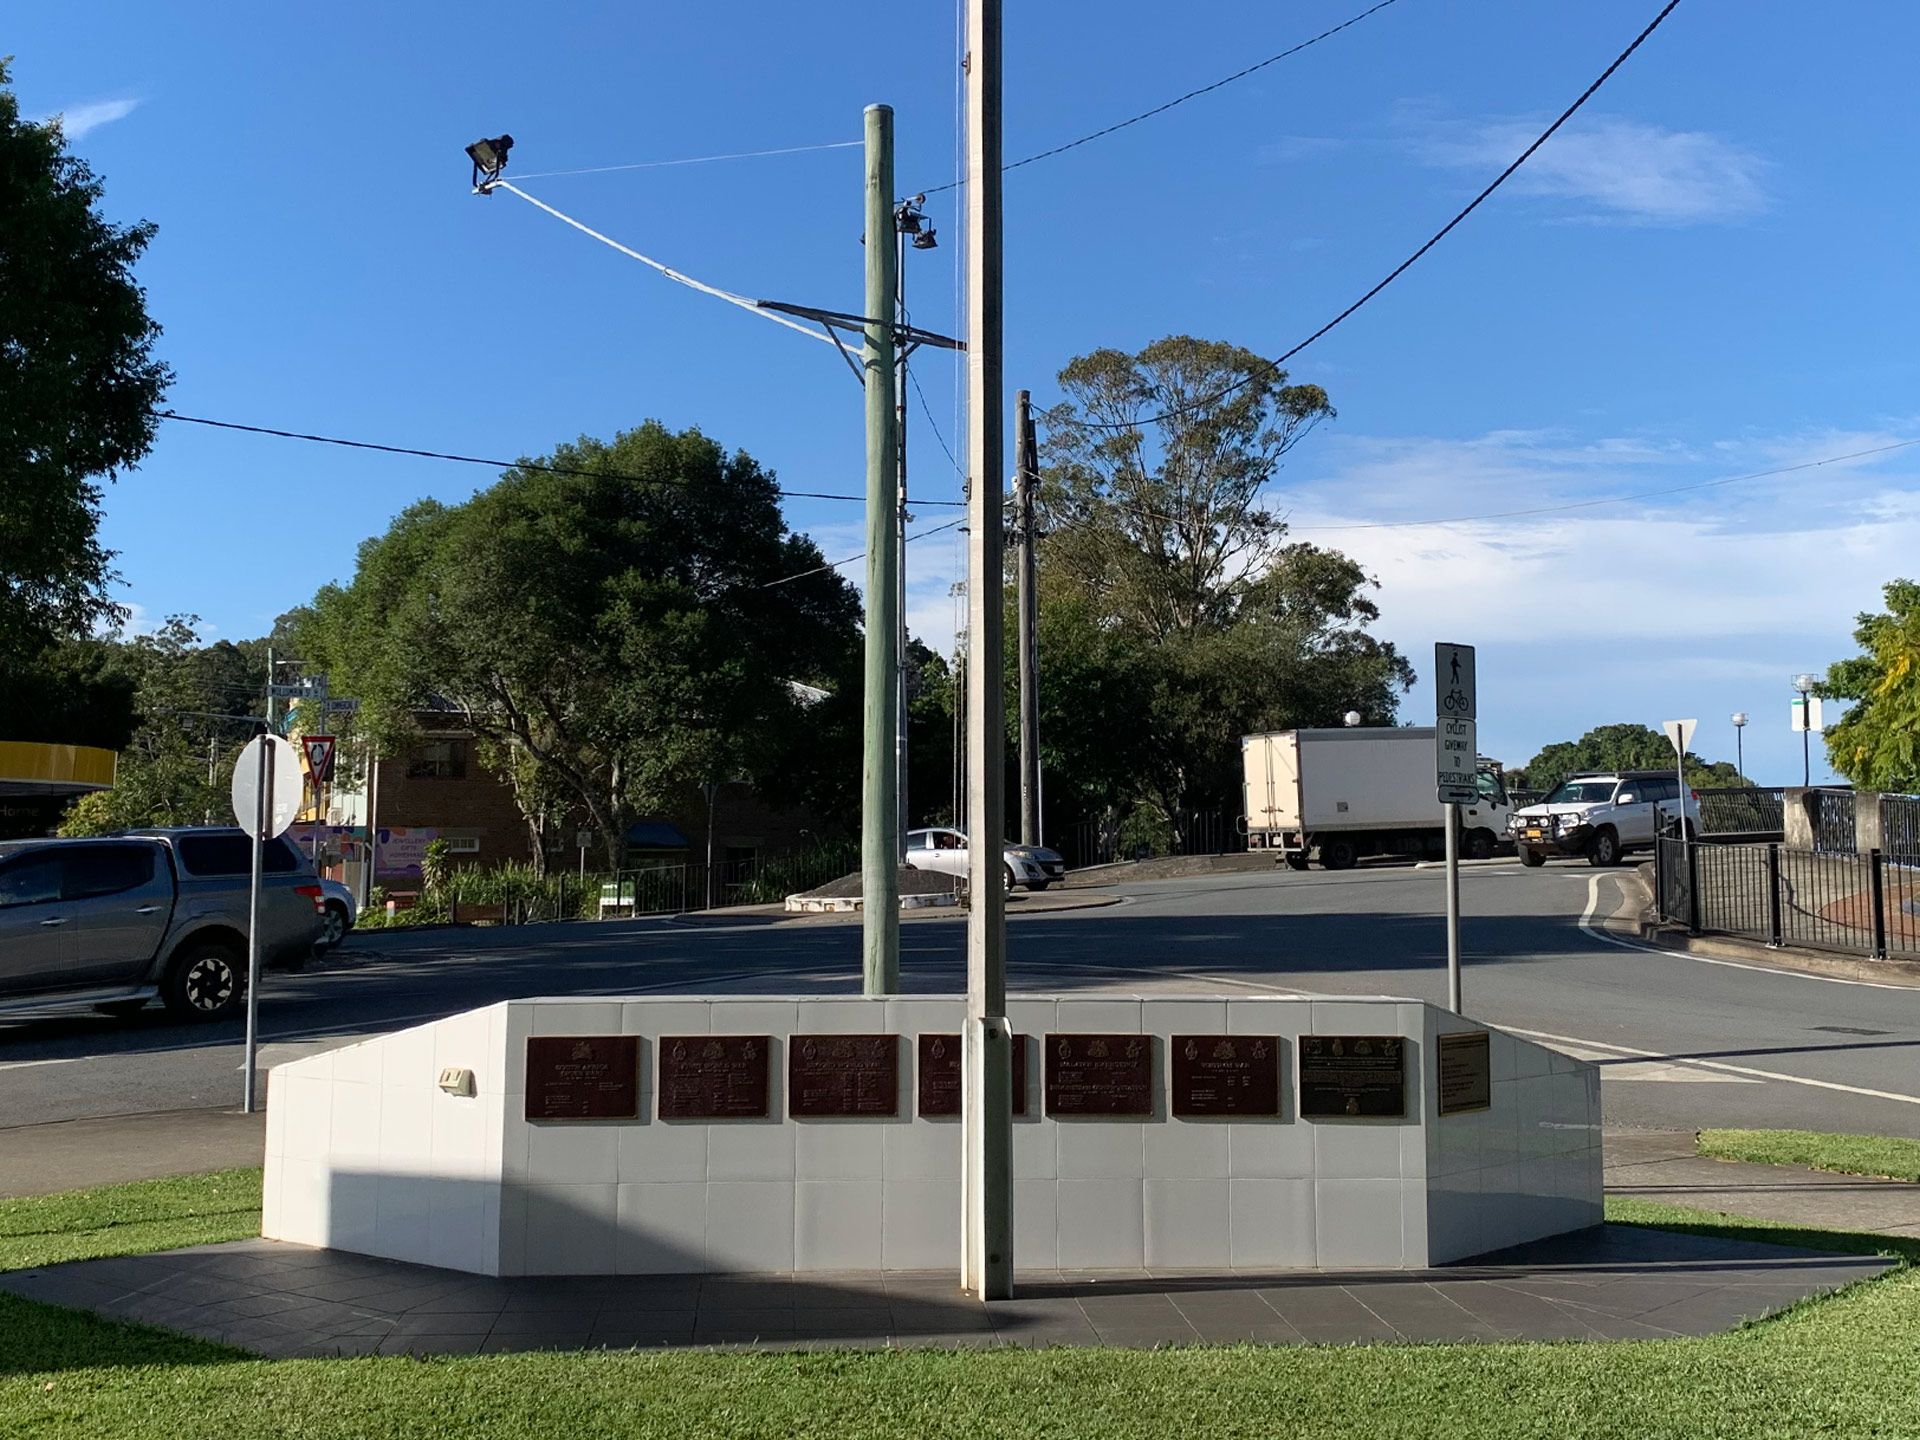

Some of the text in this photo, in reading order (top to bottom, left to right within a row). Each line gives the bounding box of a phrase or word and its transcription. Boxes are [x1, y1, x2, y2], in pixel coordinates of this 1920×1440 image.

[1446, 722, 1467, 735] CYCLIST
[1453, 756, 1461, 768] TO
[1439, 771, 1475, 785] PEDESTRIANS
